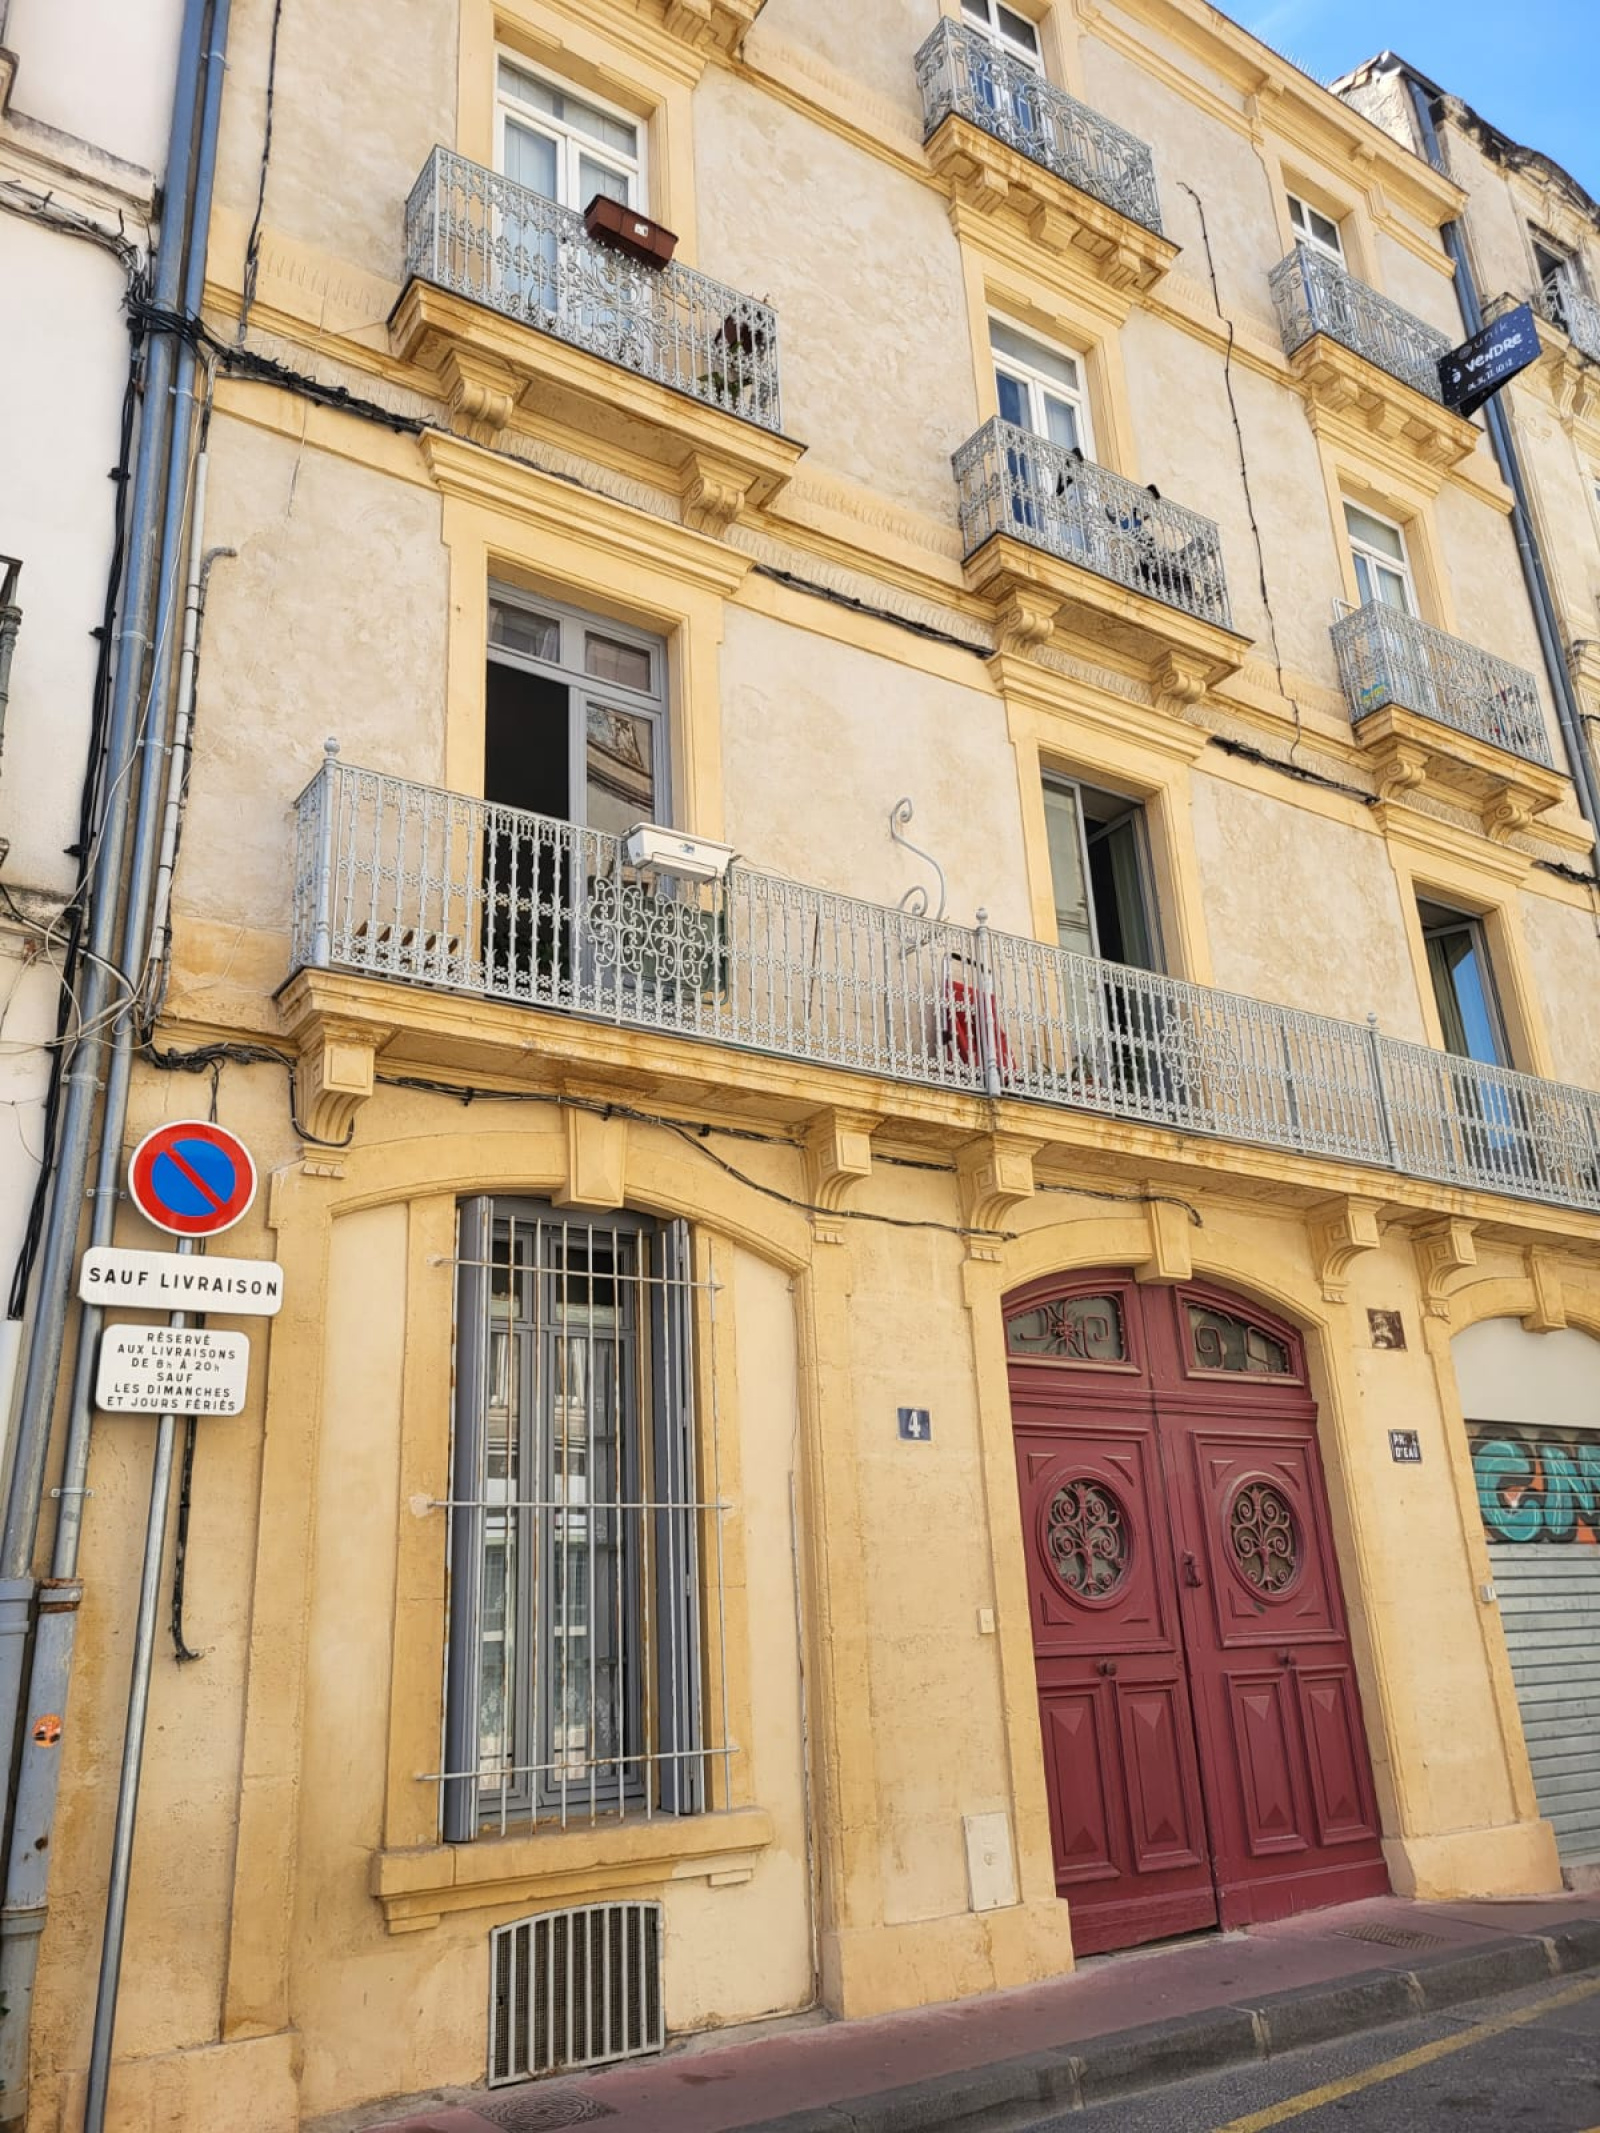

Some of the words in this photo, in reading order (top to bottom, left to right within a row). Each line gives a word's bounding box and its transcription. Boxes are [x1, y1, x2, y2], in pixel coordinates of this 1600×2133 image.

[89, 1267, 149, 1286] SAUF
[160, 1273, 277, 1296] LIVRAISON
[147, 1331, 211, 1346] RÉSERVÉ
[117, 1343, 145, 1354] AUX
[152, 1346, 236, 1360] LIVRAISONS
[131, 1358, 149, 1368] DE
[180, 1358, 187, 1370] À
[156, 1372, 194, 1383] SAUF
[114, 1383, 140, 1394] LES
[147, 1384, 231, 1398] DIMANCHES
[107, 1396, 124, 1407] ET
[131, 1397, 179, 1409] JOURS
[185, 1398, 236, 1412] FÉRIÉS
[908, 1410, 922, 1438] 4
